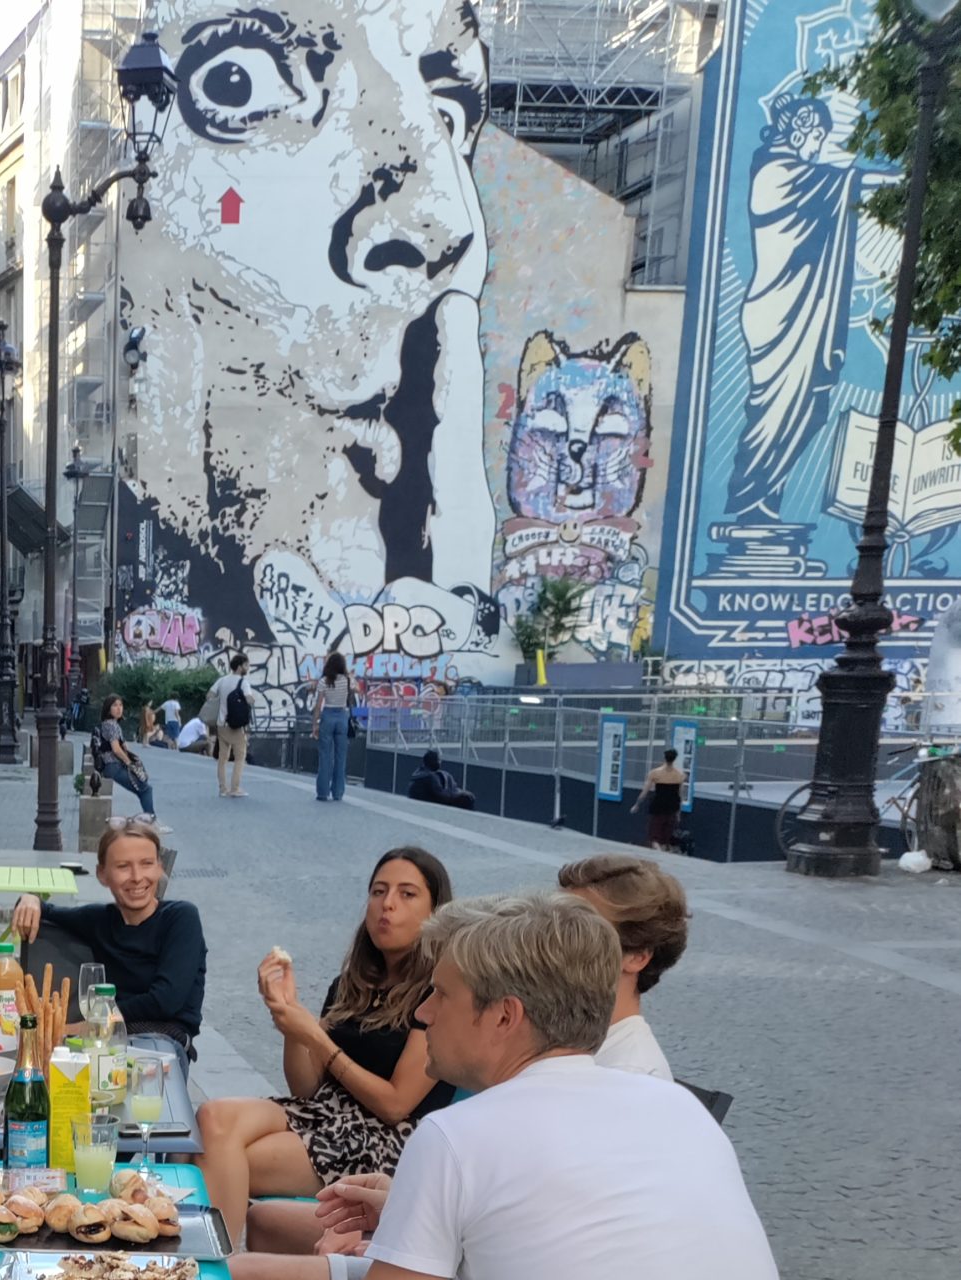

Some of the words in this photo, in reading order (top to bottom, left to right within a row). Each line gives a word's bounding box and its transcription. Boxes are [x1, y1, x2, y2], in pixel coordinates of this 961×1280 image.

[853, 461, 900, 494] FUE
[718, 593, 854, 612] KNOWLEDG
[879, 592, 961, 611] ACTIO
[343, 603, 446, 657] DPC
[0, 994, 16, 1004] Tropic
